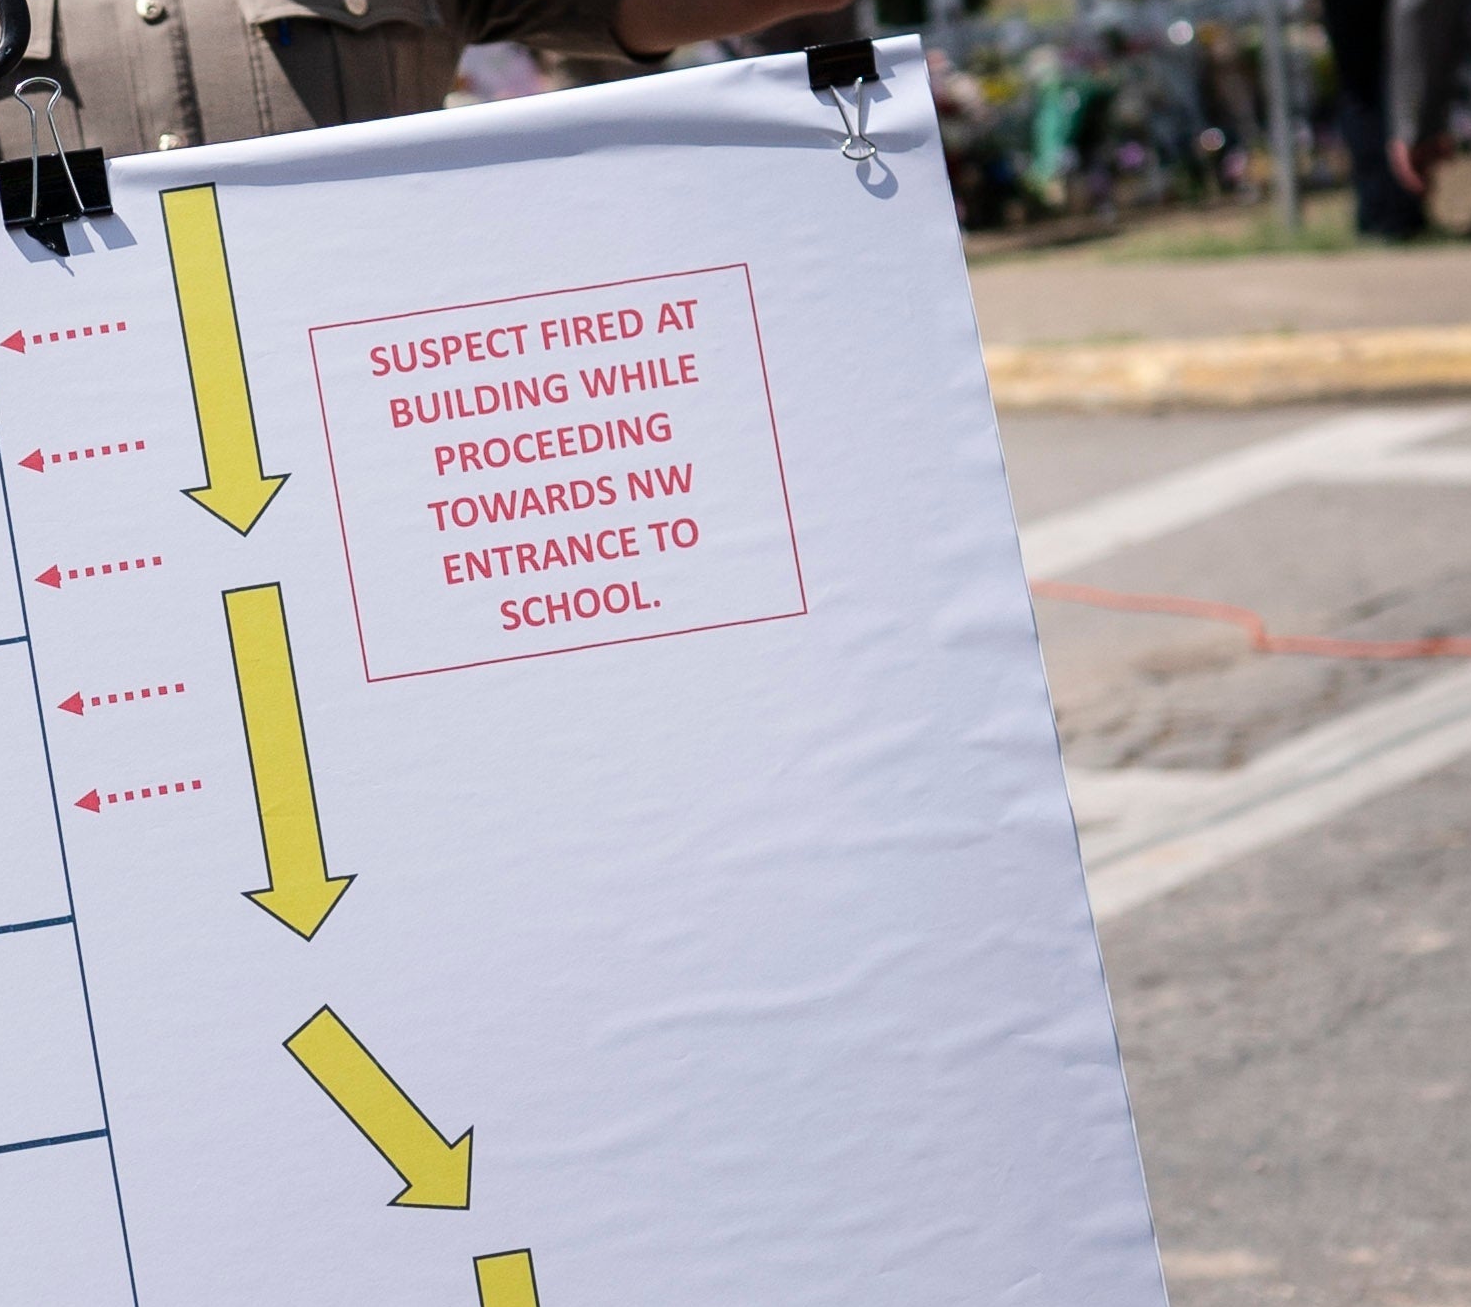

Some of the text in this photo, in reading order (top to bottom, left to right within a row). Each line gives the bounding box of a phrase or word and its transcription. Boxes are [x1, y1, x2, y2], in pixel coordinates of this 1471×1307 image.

[370, 299, 697, 376] SUSPECT FIRED AT
[390, 354, 698, 428] BUILDING WHILE
[434, 412, 673, 476] PROCEEDING
[429, 464, 692, 531] TOWARDS NW
[443, 518, 699, 584] ENTRANCE TO
[500, 582, 660, 630] SCHOOL.
